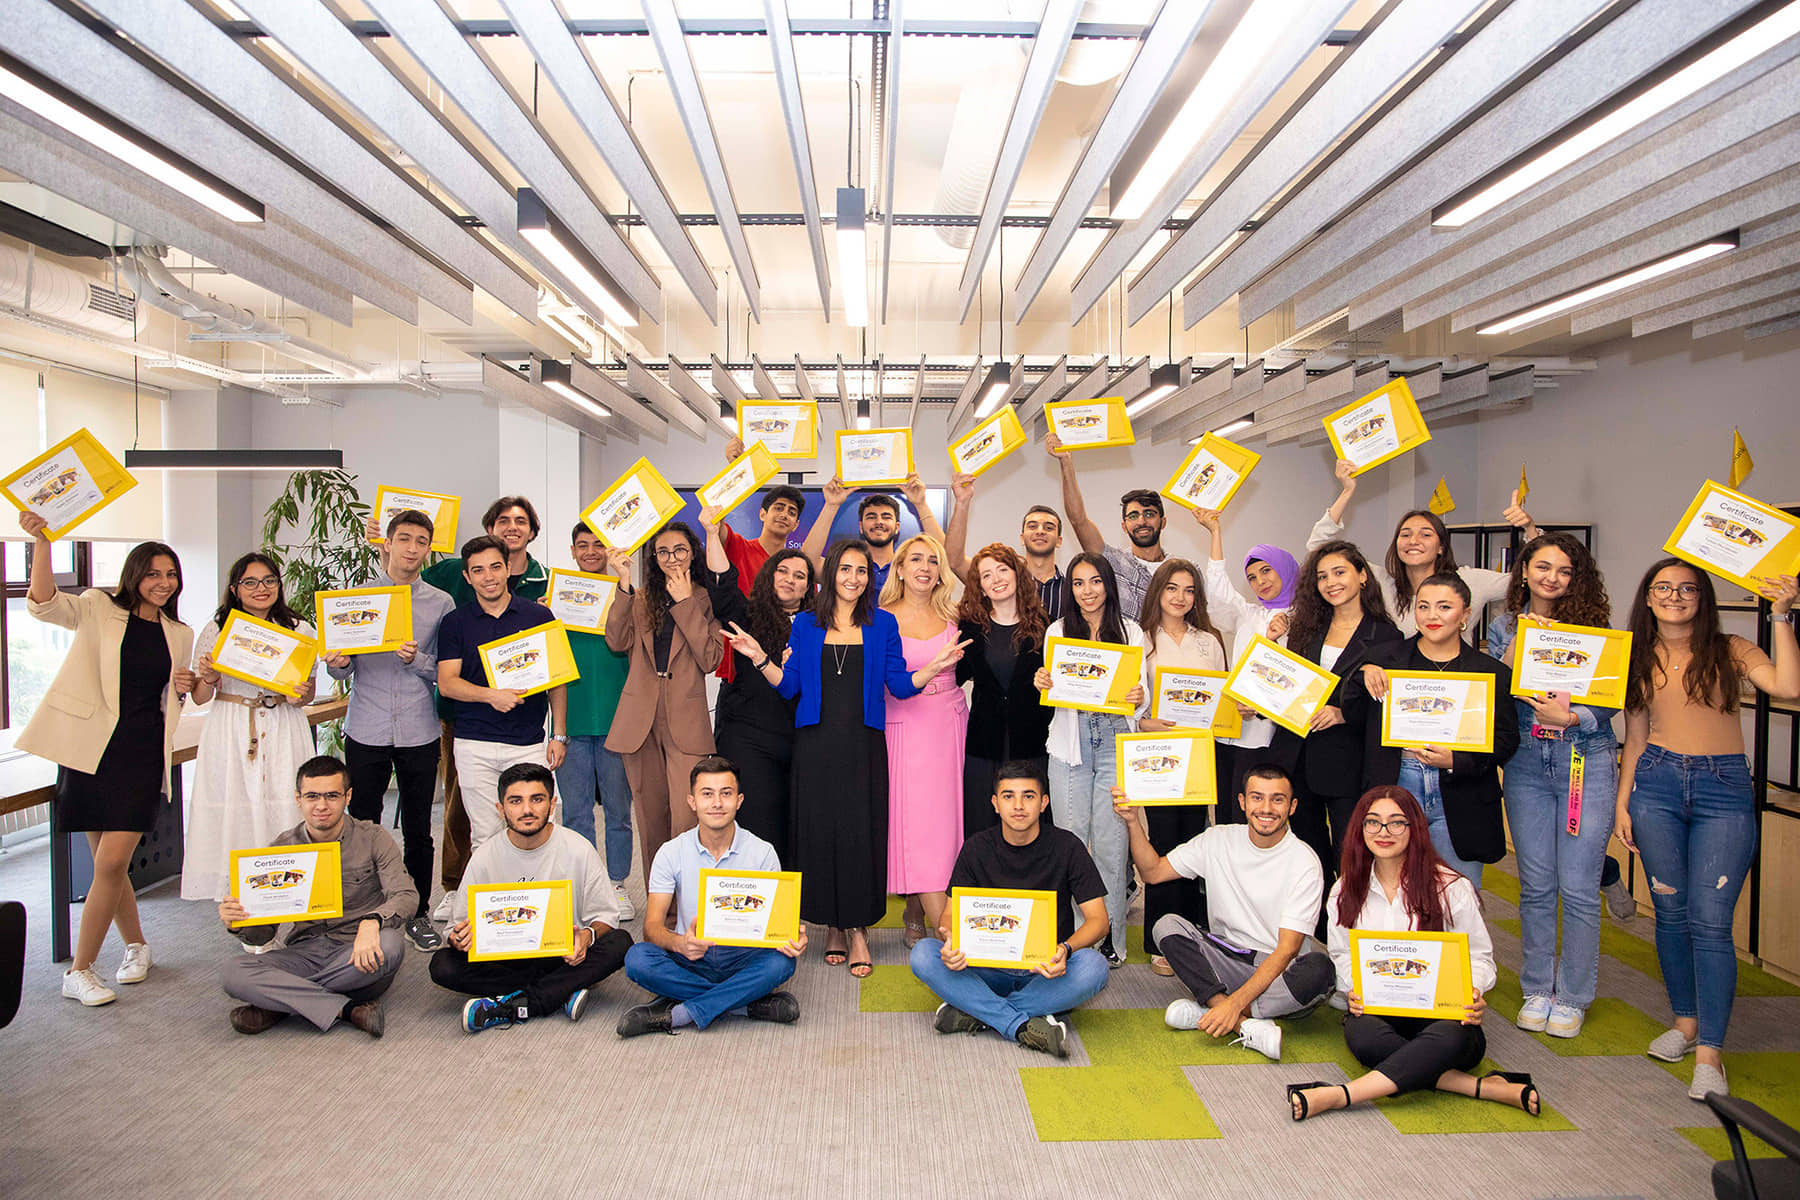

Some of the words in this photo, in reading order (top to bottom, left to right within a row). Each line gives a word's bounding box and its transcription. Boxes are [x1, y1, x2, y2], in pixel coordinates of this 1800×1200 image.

[23, 463, 60, 488] Certificate
[1720, 502, 1764, 525] Certificate
[1539, 635, 1581, 646] Certificate
[498, 642, 529, 656] Certificate
[1066, 650, 1102, 659] Certificate
[1264, 652, 1296, 673] Certificate
[1172, 678, 1206, 686] Certificate
[1405, 684, 1446, 692] Certificate
[254, 858, 295, 868] Certificate
[719, 881, 757, 889] Certificate
[490, 895, 529, 903] Certificate
[973, 901, 1011, 910] Certificate
[1373, 944, 1417, 953] Certificate
